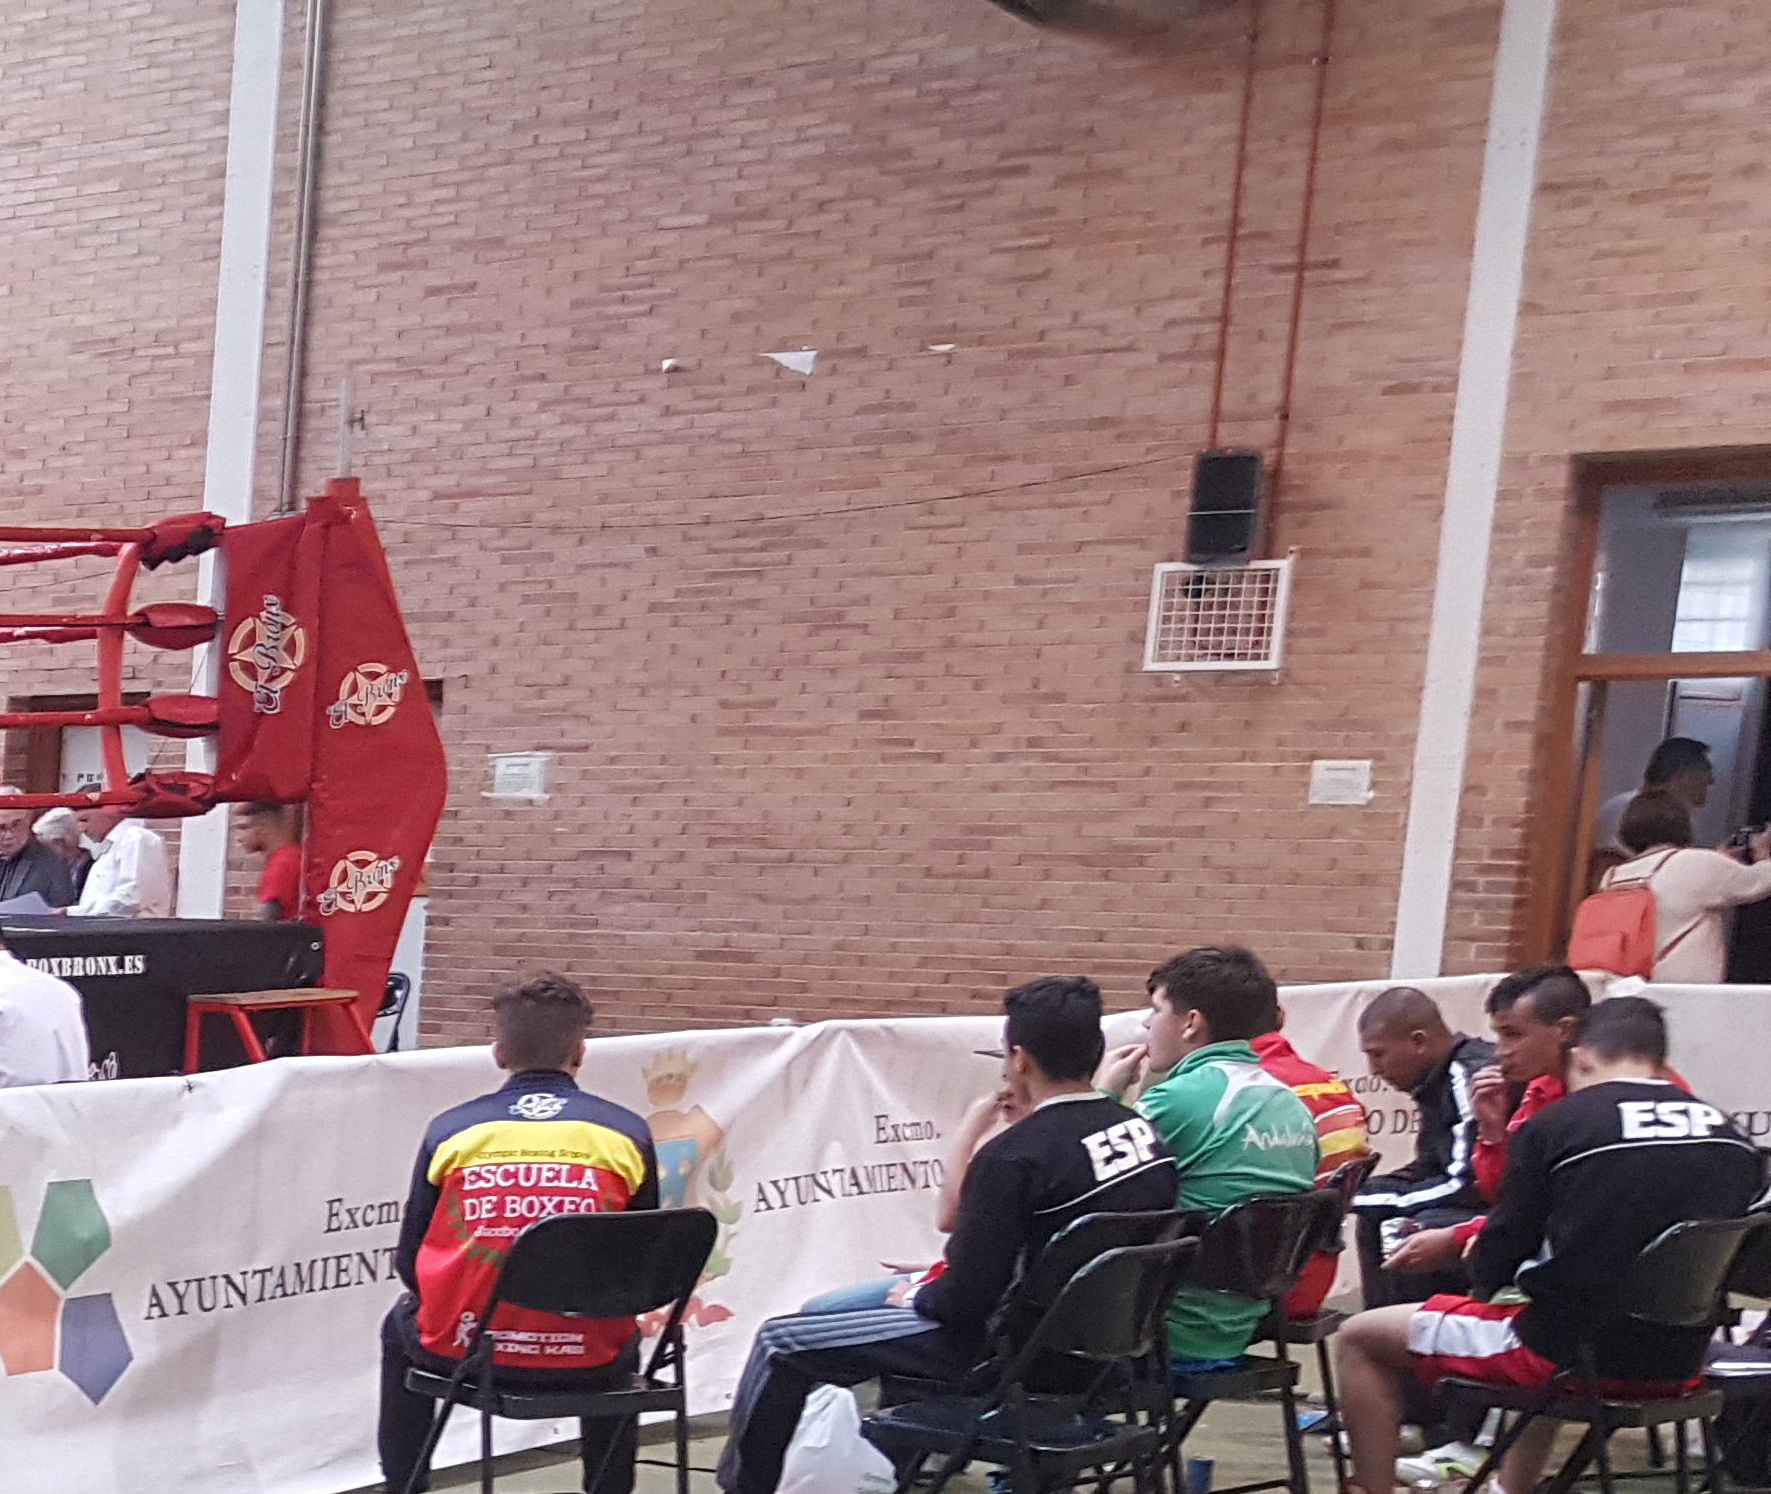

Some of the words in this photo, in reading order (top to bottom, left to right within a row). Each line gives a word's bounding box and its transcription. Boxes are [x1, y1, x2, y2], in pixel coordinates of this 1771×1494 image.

[1617, 1101, 1725, 1139] ESP
[1081, 1117, 1157, 1182] ESP
[462, 1163, 599, 1192] ESCUELA
[754, 1158, 944, 1213] AYUNTAMIENTO
[323, 1197, 402, 1234] Excm
[463, 1197, 497, 1221] DE
[143, 1246, 398, 1321] AYUNTAMIENT
